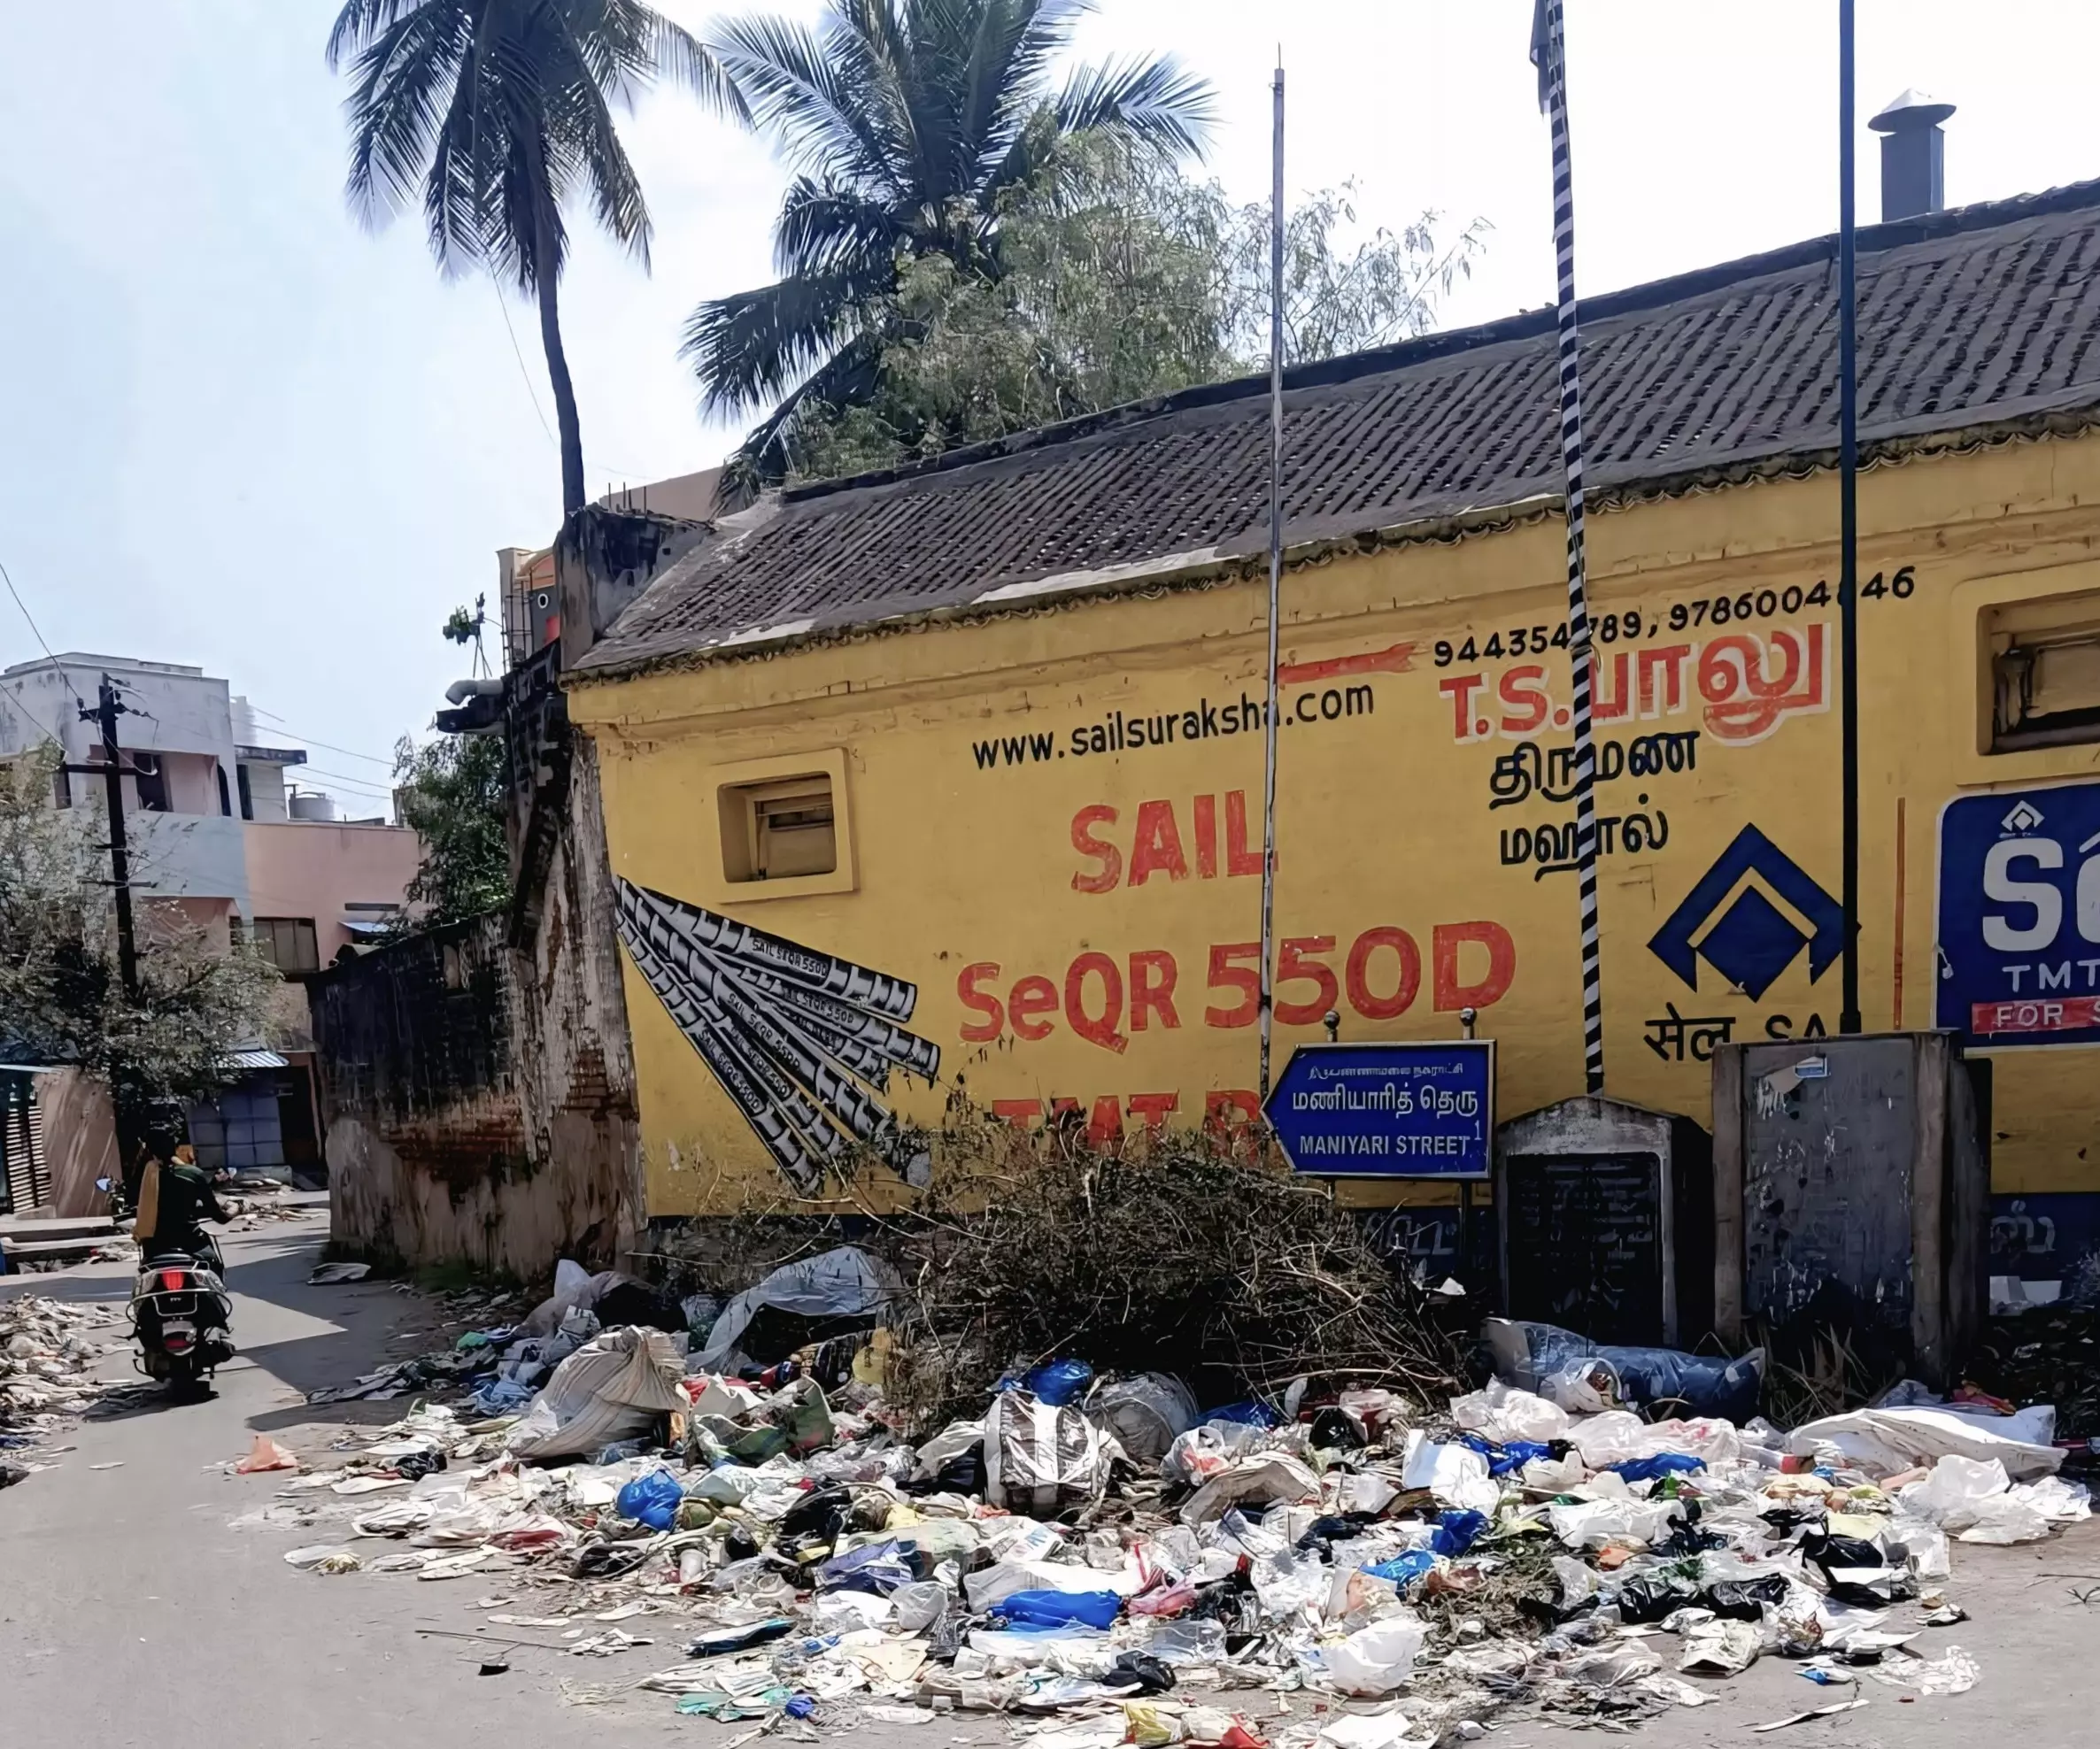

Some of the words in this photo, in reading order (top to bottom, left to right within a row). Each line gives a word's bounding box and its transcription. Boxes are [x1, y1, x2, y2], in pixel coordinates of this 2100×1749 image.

[973, 683, 1374, 770] www.sailsuraksha.com
[1070, 790, 1279, 894] SAIL
[956, 950, 1182, 1056] SeQR
[1204, 921, 1517, 1029] 550D
[1643, 1002, 1736, 1061] सेल
[1996, 1002, 2064, 1028] FOR
[1293, 1082, 1413, 1119] மணியாரித்
[1419, 1085, 1478, 1119] தெரு
[1300, 1135, 1389, 1155] MANIYARI
[1395, 1135, 1471, 1157] STREET
[1474, 1120, 1484, 1141] 1
